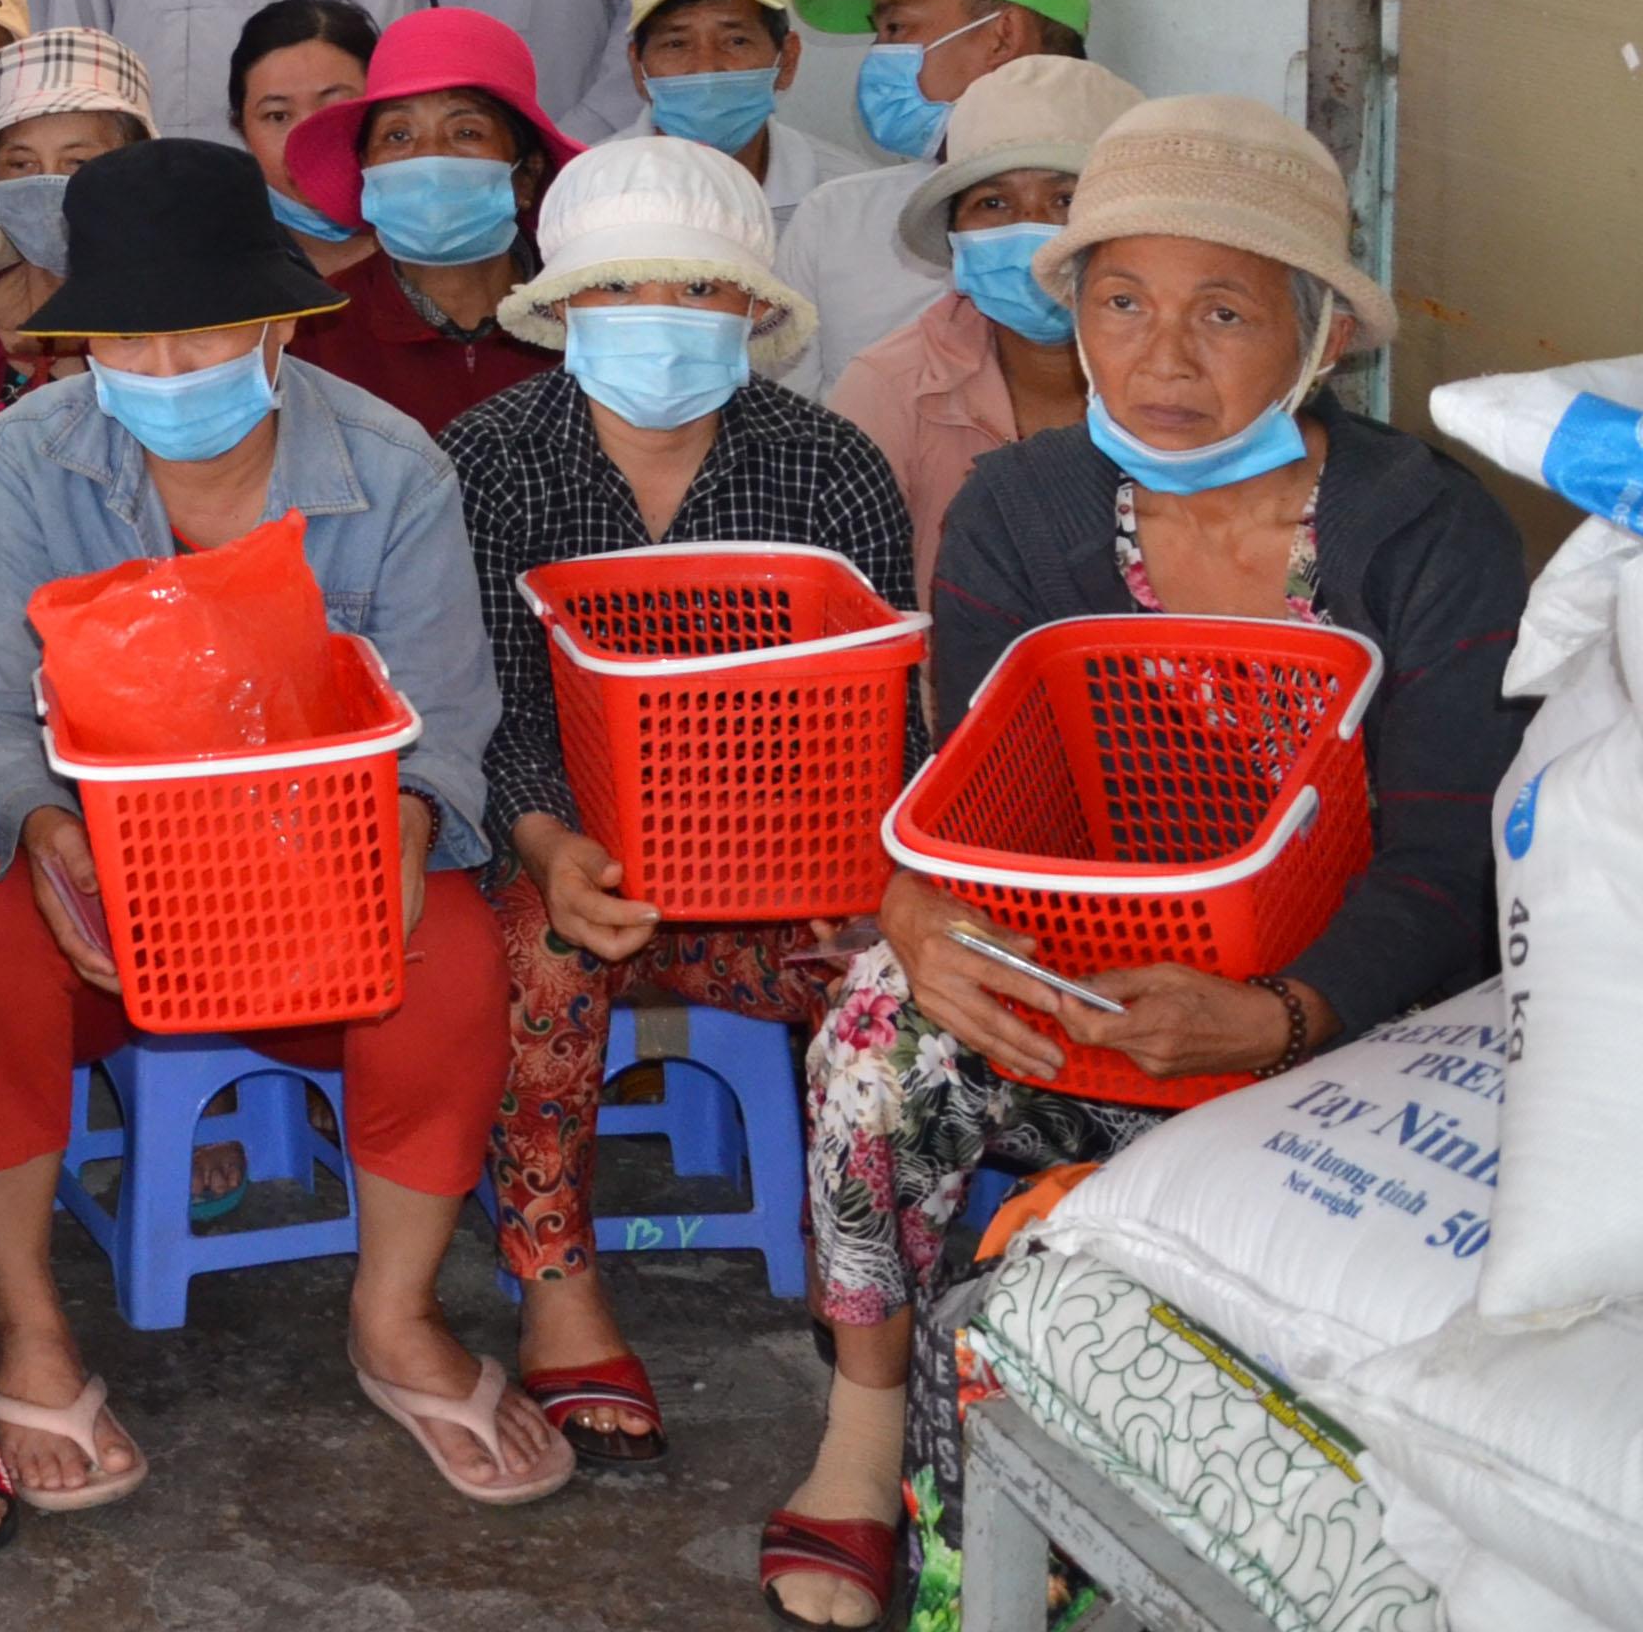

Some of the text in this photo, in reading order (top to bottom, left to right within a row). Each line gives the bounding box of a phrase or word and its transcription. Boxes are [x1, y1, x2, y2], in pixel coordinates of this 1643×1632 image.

[1507, 897, 1530, 967] 40
[1287, 1080, 1381, 1130] Tay
[1282, 1169, 1364, 1219] Net weight
